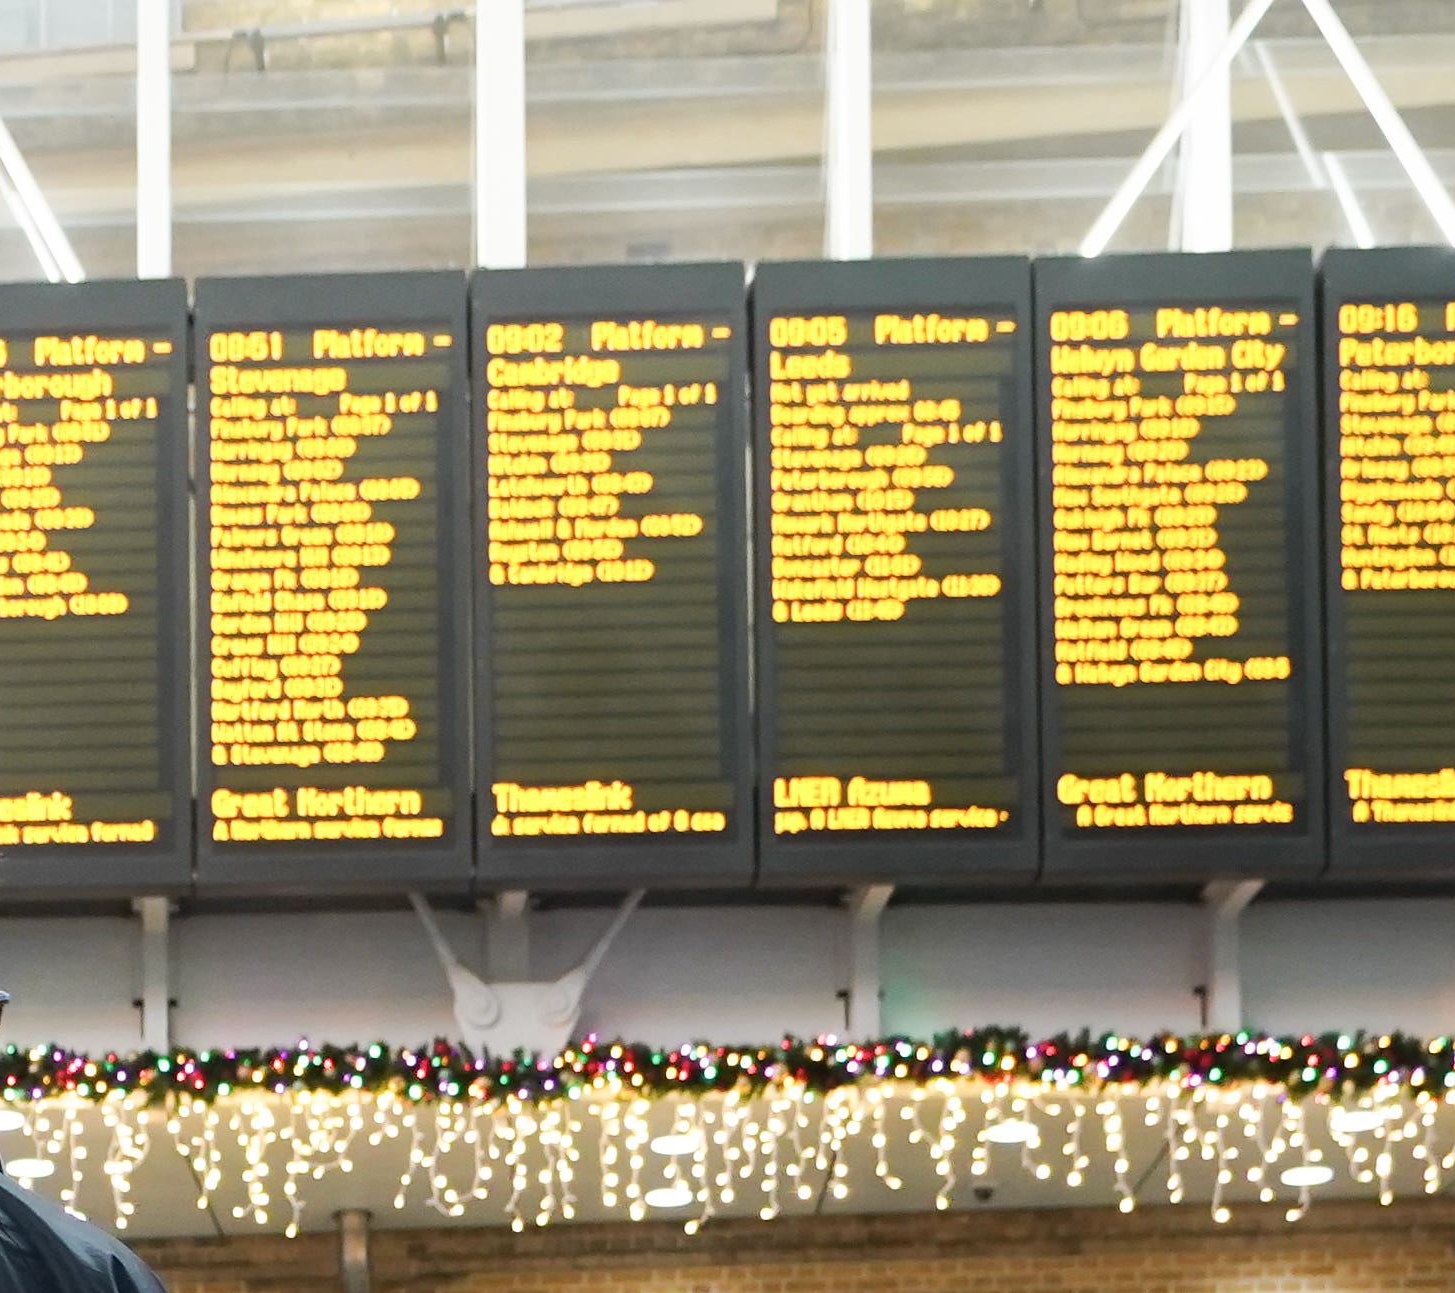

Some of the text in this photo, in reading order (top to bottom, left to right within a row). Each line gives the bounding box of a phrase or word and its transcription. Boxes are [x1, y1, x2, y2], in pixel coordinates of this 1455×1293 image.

[589, 320, 705, 351] Platform
[874, 314, 990, 344] Platform
[1155, 307, 1272, 338] Platform
[32, 335, 148, 366] Platform
[312, 328, 426, 359] Platform
[1050, 339, 1285, 378] Welwyn Garden City
[209, 365, 348, 396] Stevenage
[487, 356, 622, 389] Cambridge
[770, 349, 852, 381] Leeds
[211, 786, 422, 820] Great Northern
[492, 780, 633, 813] Thameslink
[1057, 772, 1273, 806] Great Northern
